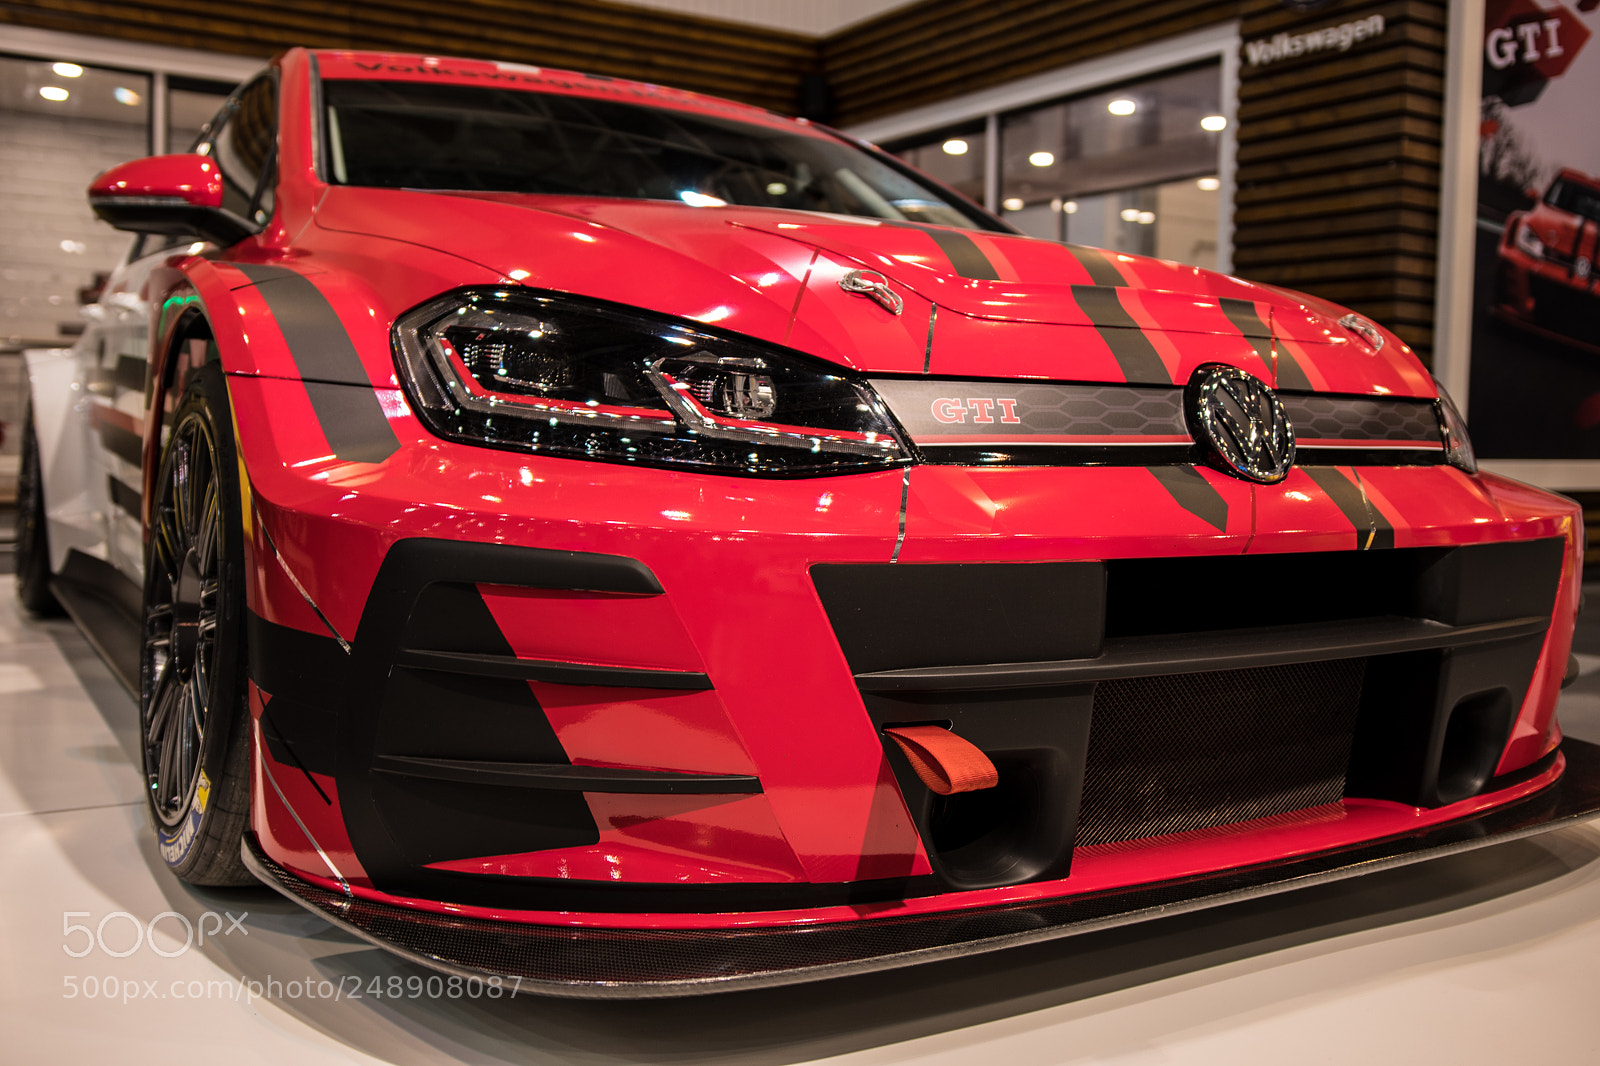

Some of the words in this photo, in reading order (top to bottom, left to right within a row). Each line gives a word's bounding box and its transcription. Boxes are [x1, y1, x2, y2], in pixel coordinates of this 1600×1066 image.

[1246, 14, 1385, 66] Volkswagen
[1486, 18, 1564, 69] GTI
[931, 397, 1021, 424] GTI
